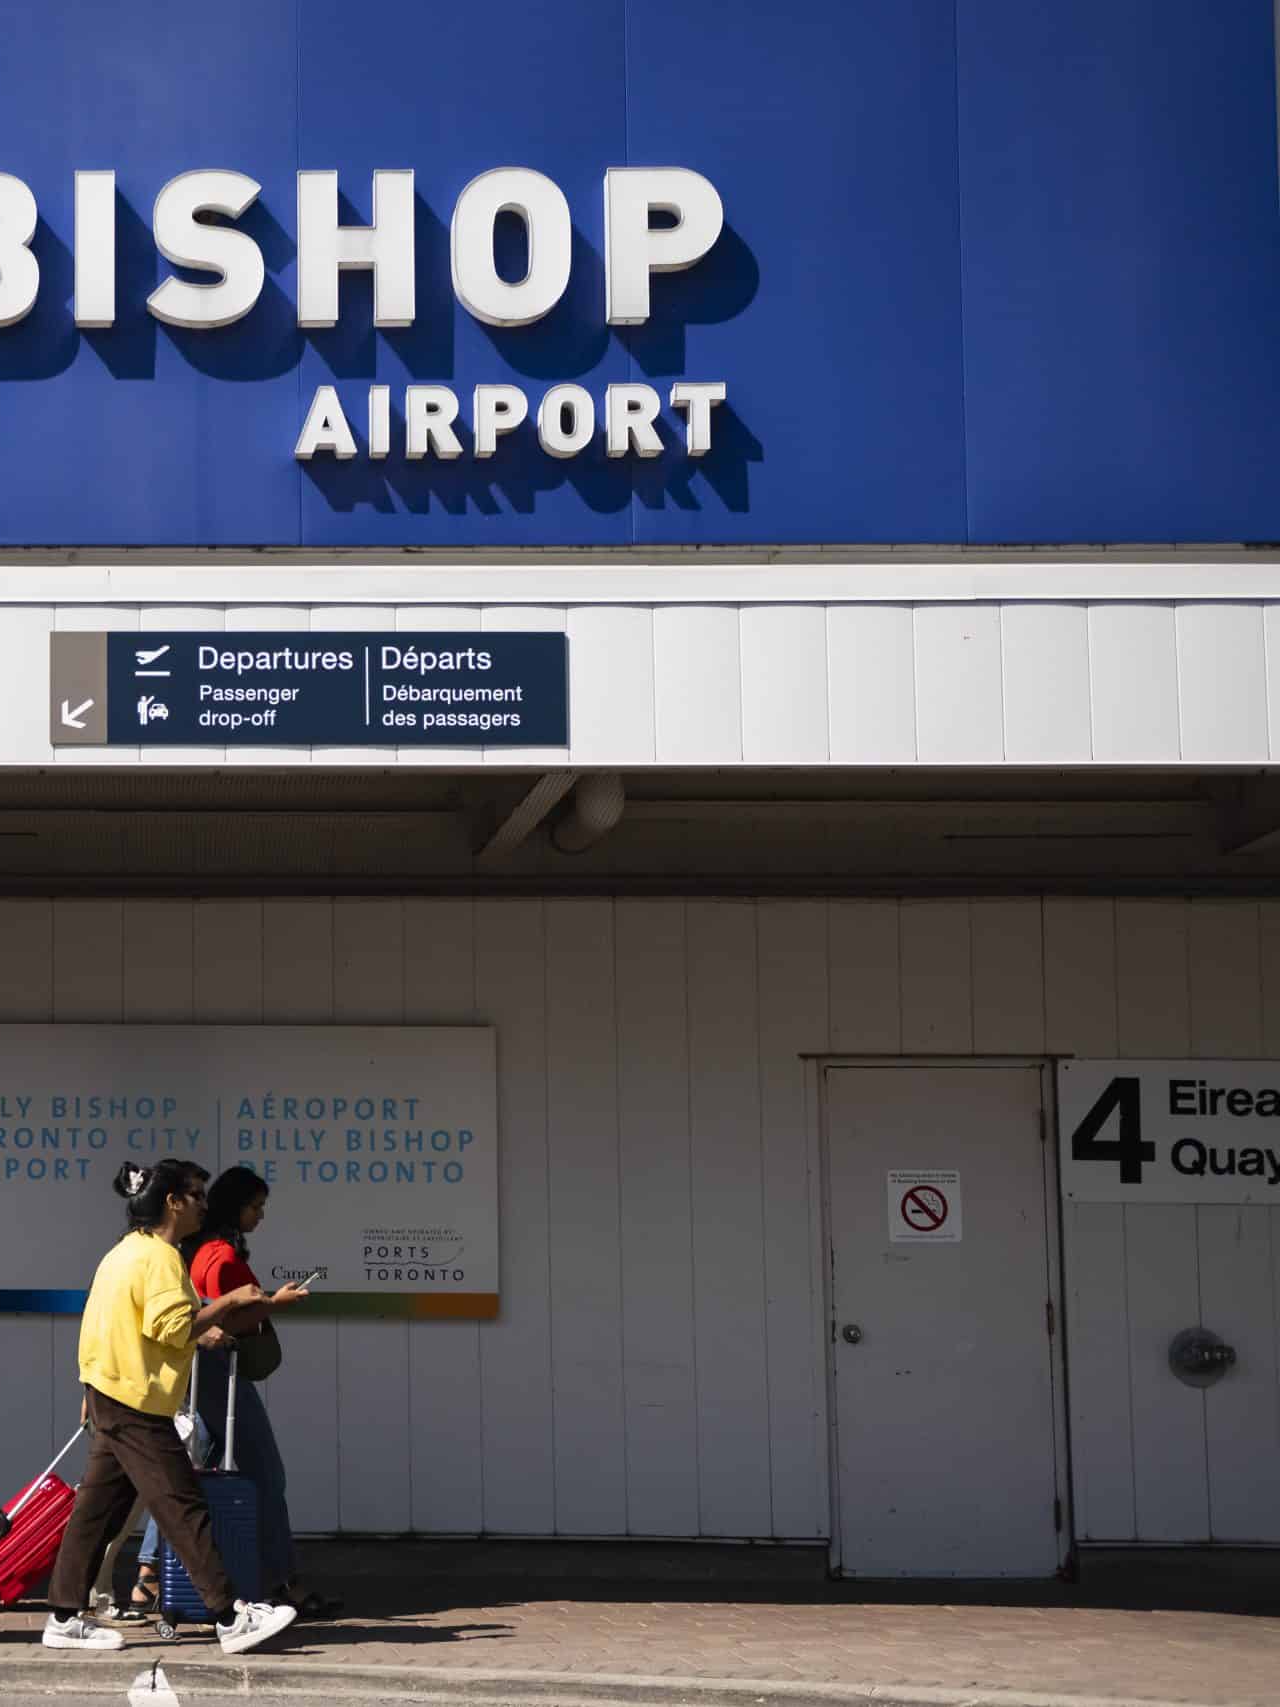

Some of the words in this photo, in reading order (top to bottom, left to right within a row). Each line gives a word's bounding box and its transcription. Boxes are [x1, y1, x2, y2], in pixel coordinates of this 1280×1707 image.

[294, 382, 726, 462] AIRPORT
[198, 646, 354, 676] Departures
[381, 645, 493, 675] Départs
[199, 684, 300, 707] Passenger
[382, 684, 523, 707] Débarquement
[199, 710, 277, 730] drop-off
[382, 710, 416, 727] des
[422, 713, 522, 730] passagers
[51, 1097, 178, 1120] BISHOP
[236, 1092, 422, 1121] AÉROPORT
[127, 1128, 202, 1151] CITY
[238, 1129, 326, 1152] BILLY
[346, 1130, 475, 1153] BISHOP
[1072, 1077, 1156, 1184] 4
[297, 1161, 466, 1184] TORONTO
[364, 1246, 430, 1258] PORTS
[365, 1269, 464, 1281] TORONTO
